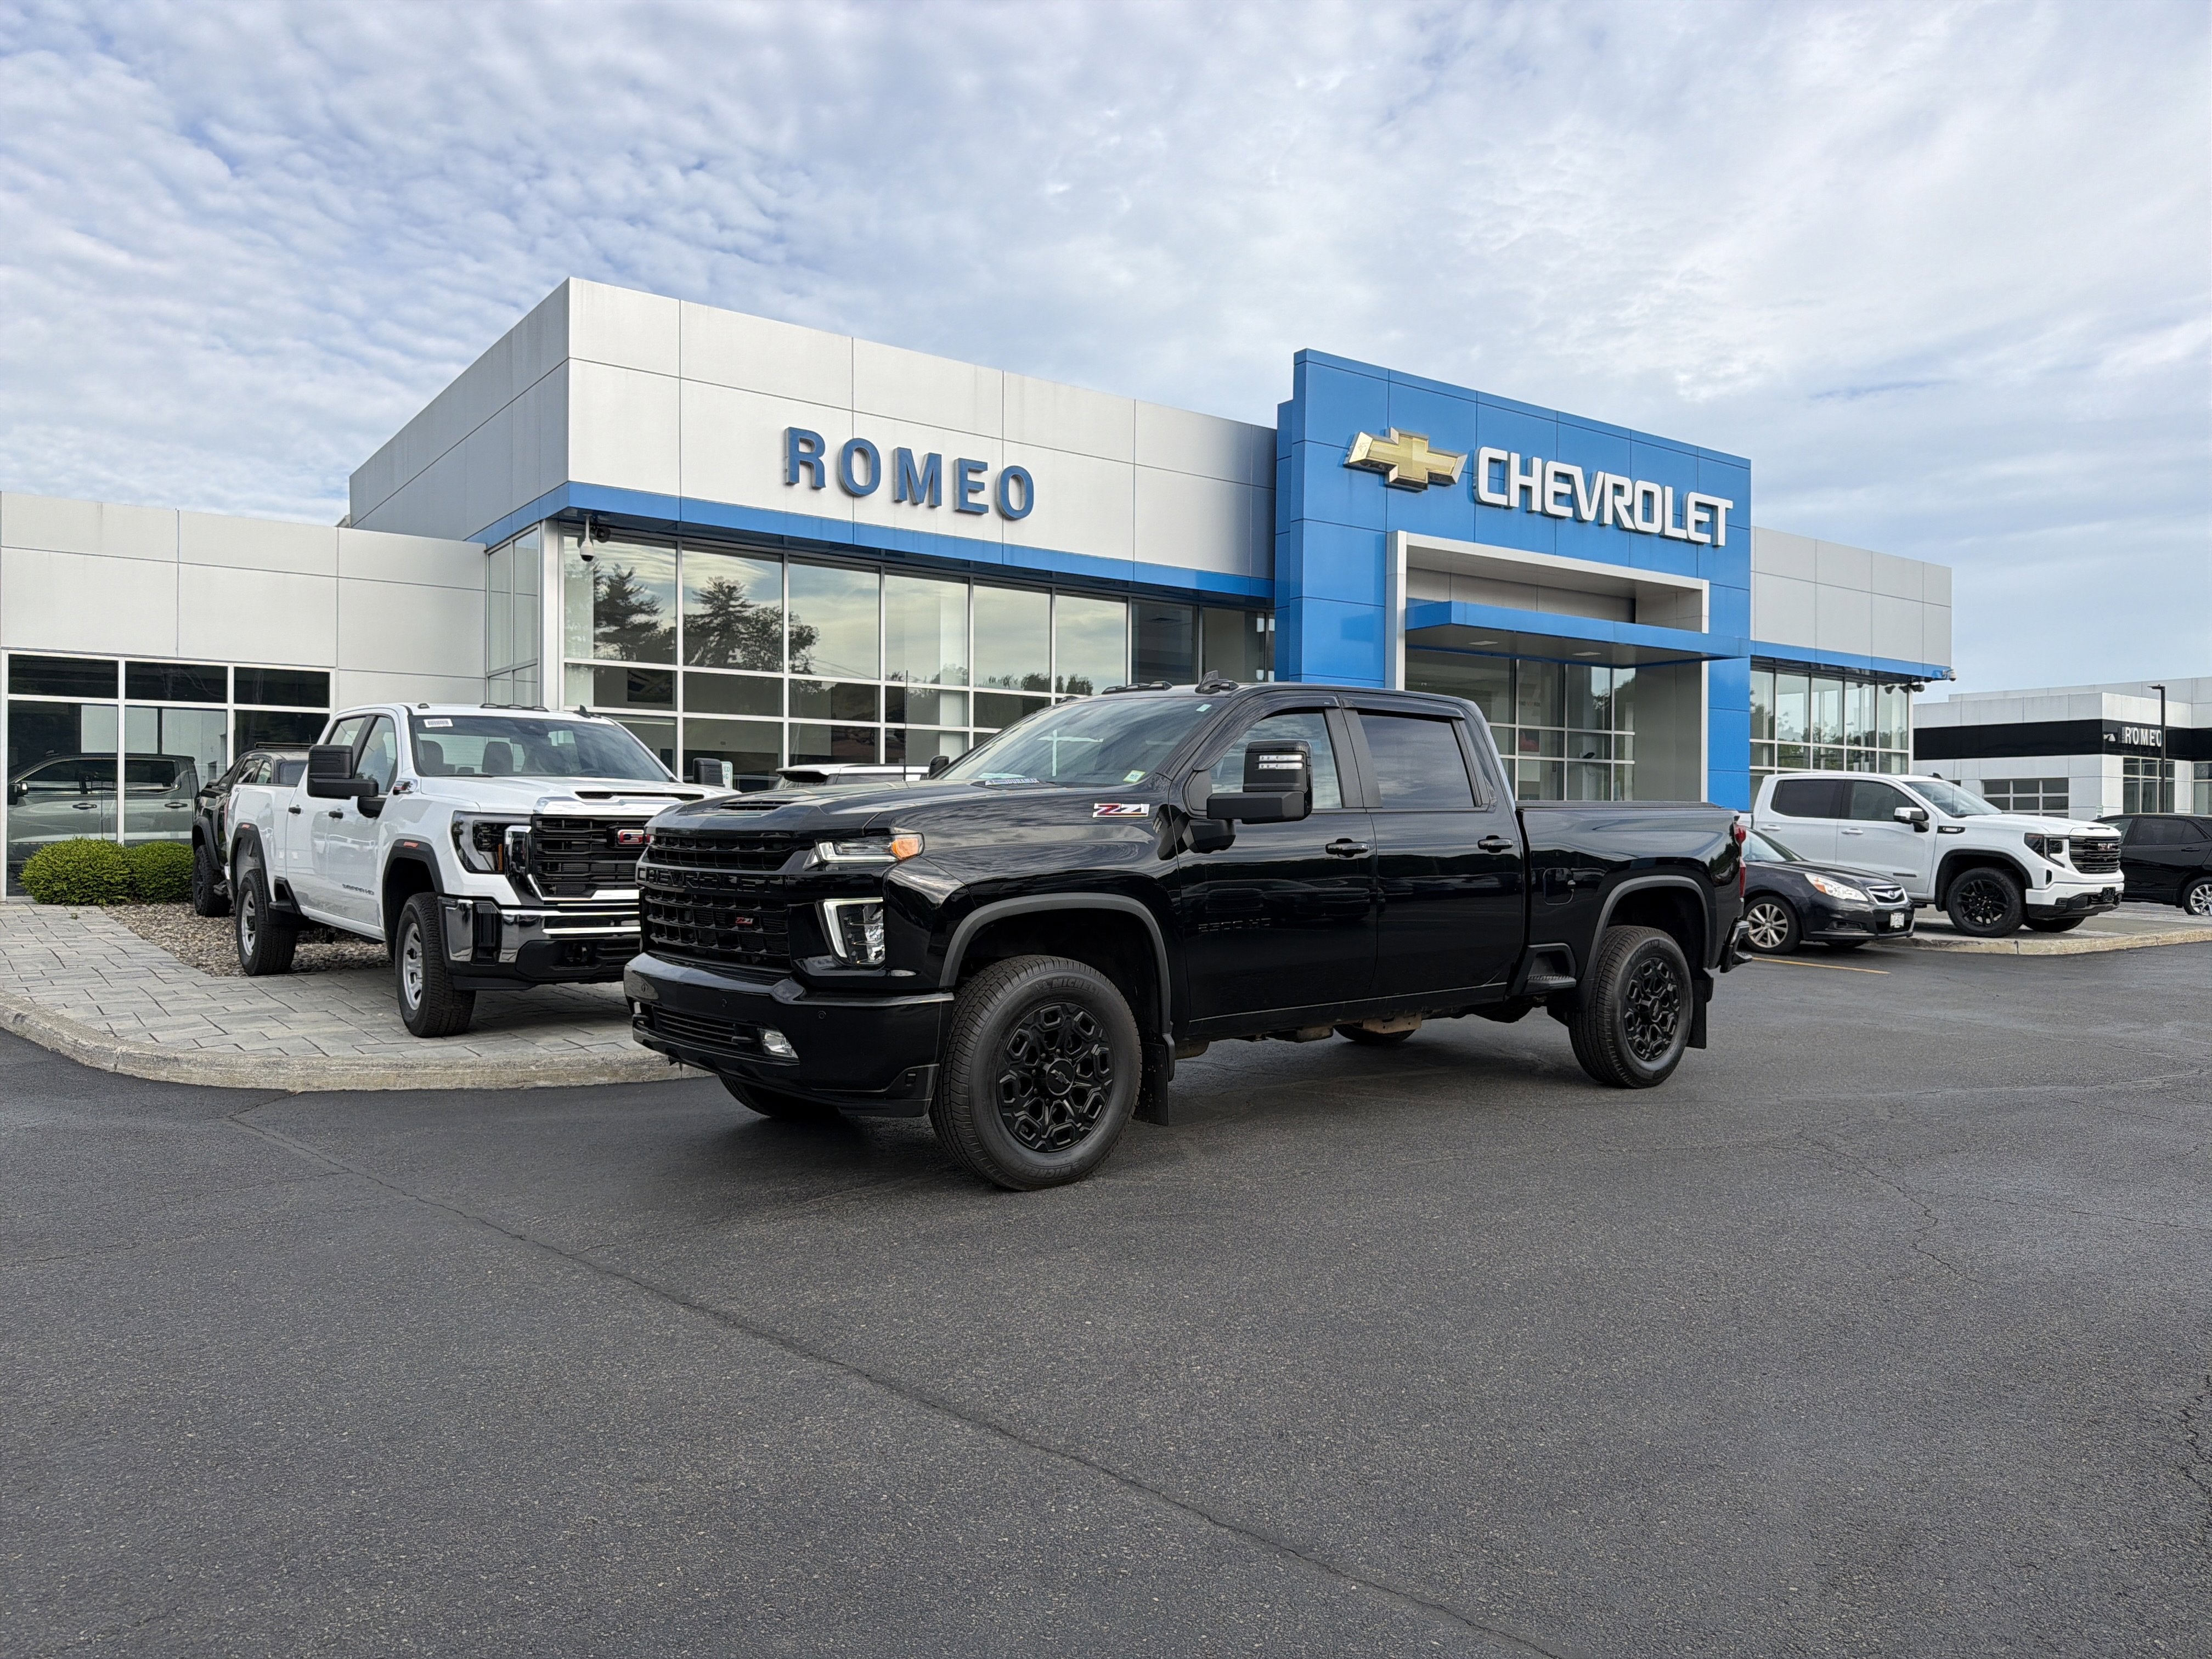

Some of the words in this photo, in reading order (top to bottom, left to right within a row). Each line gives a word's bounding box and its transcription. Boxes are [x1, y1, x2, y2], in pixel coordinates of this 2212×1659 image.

[785, 426, 1035, 521] ROMEO
[1475, 446, 1734, 548] CHEVROLET
[2123, 726, 2162, 747] ROMEO
[1092, 803, 1150, 817] Z71
